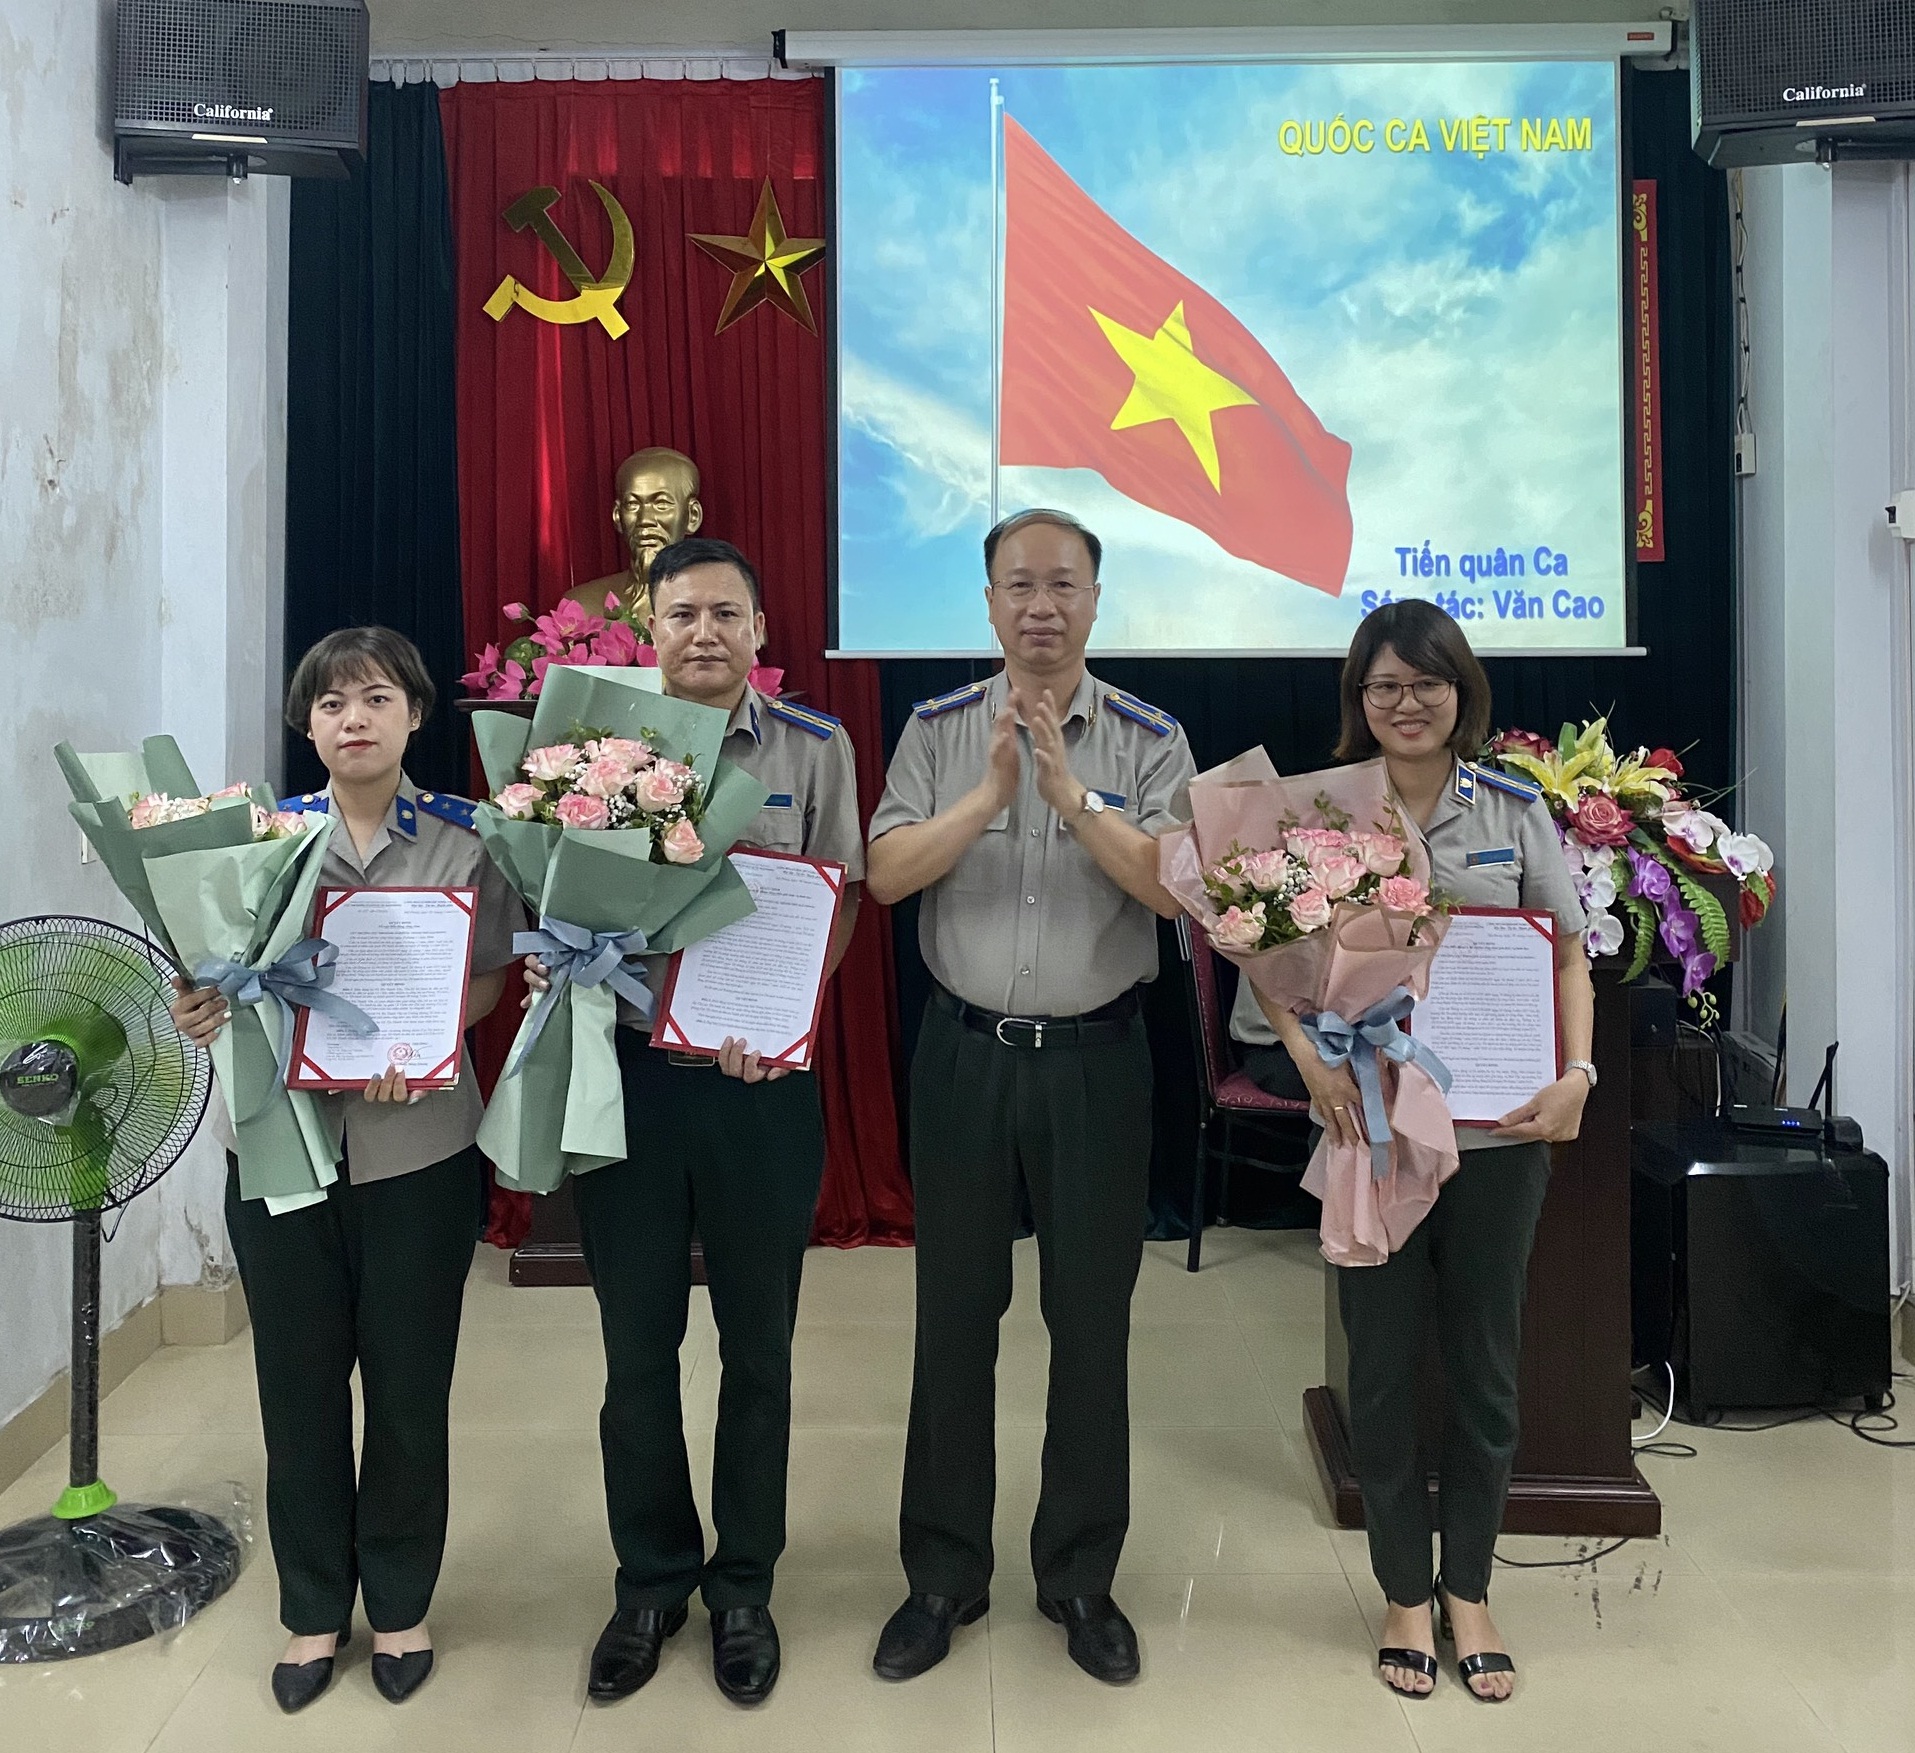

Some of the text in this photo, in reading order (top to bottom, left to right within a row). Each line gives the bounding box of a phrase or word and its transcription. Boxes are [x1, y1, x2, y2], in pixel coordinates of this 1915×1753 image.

[1782, 83, 1866, 101] California
[193, 103, 272, 121] California
[1278, 112, 1592, 159] QUỐC CA VIỆT NAM
[1395, 539, 1568, 584] Tiến quân Ca
[1492, 589, 1544, 619] Văn
[1552, 589, 1605, 619] Cao
